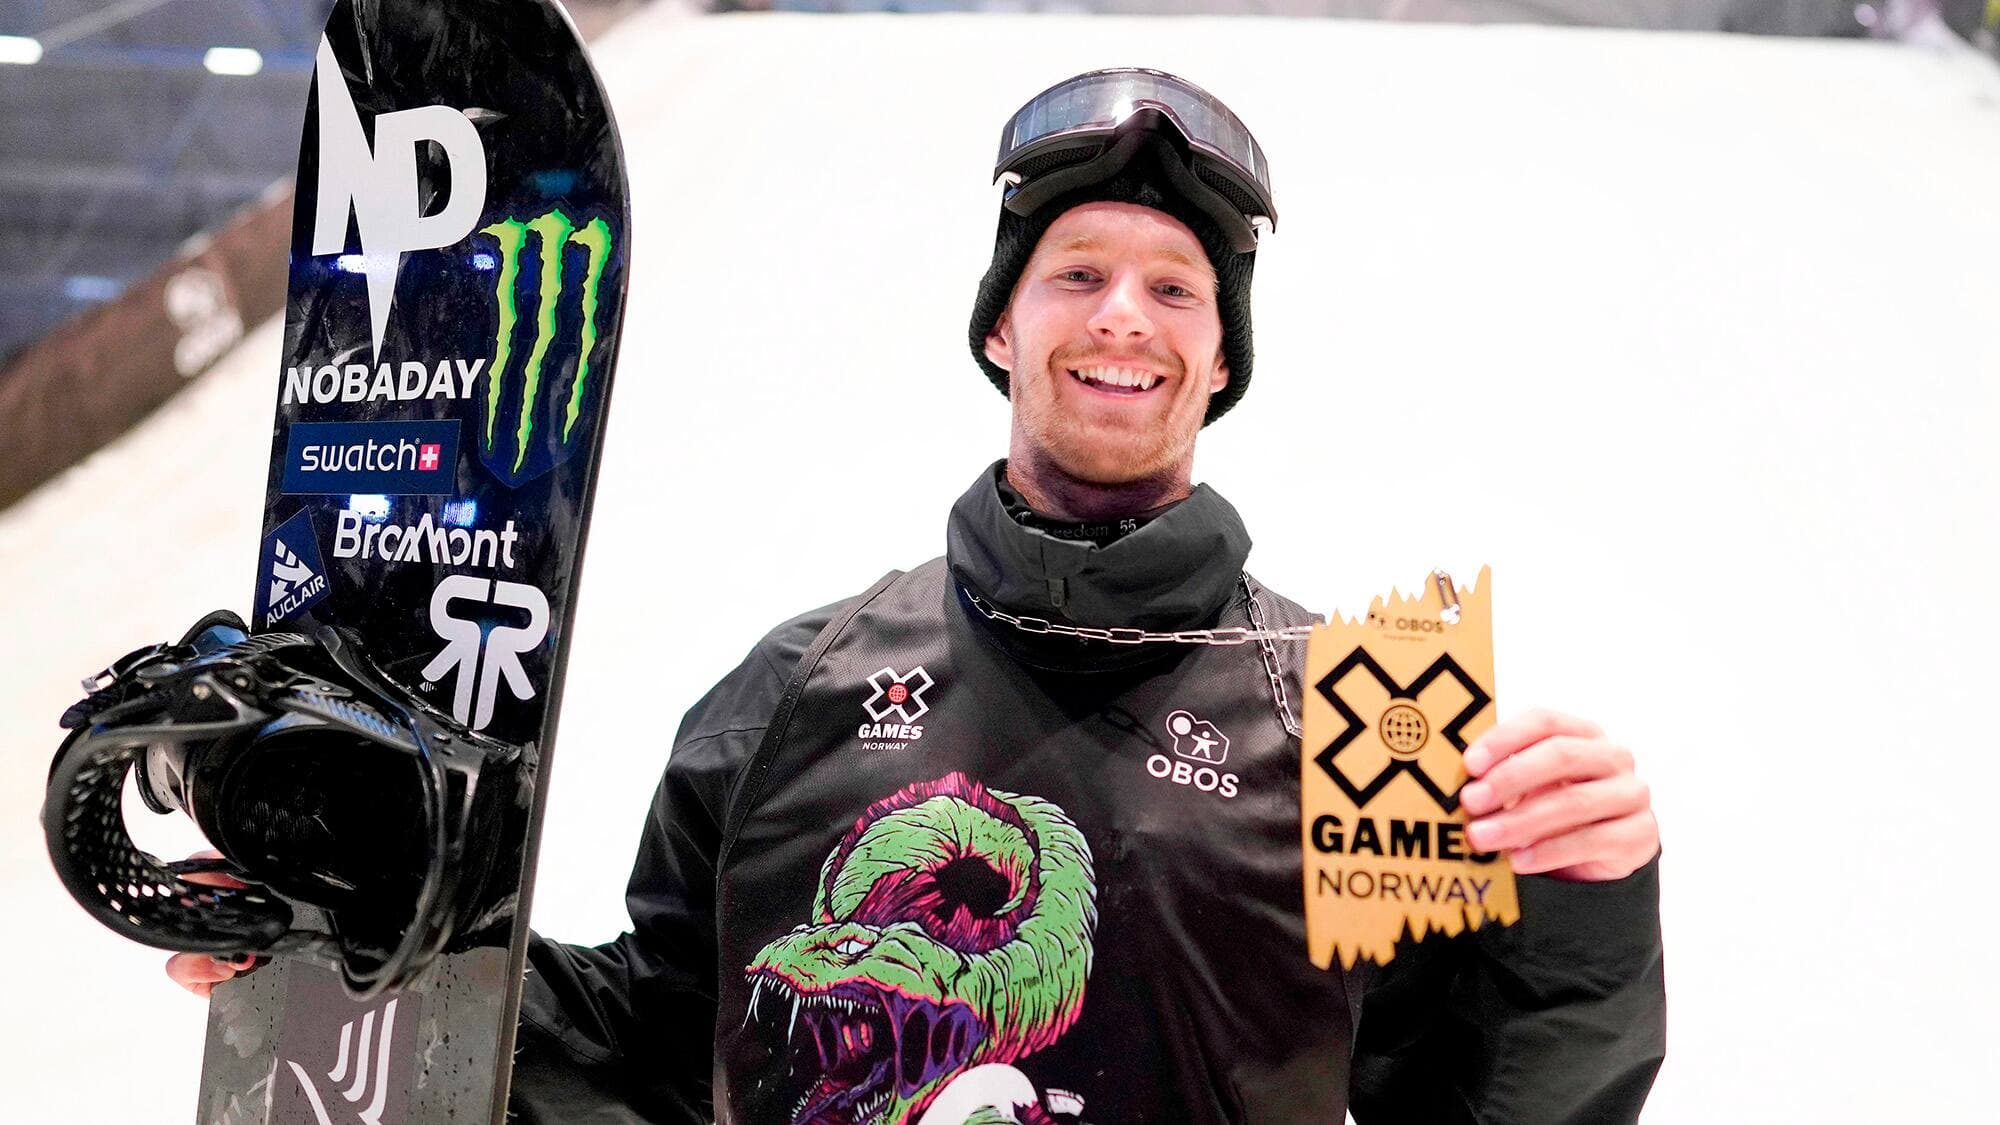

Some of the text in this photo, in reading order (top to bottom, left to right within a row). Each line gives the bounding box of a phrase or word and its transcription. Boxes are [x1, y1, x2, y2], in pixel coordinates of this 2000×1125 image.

[283, 359, 486, 404] NOBADAY
[1119, 518, 1137, 535] 55
[266, 575, 326, 629] AUCLAIR
[1395, 617, 1444, 634] OBOS
[858, 723, 924, 740] GAMES
[862, 742, 908, 751] NORWAY
[1146, 754, 1240, 799] OBOS
[1317, 868, 1492, 905] NORWAY
